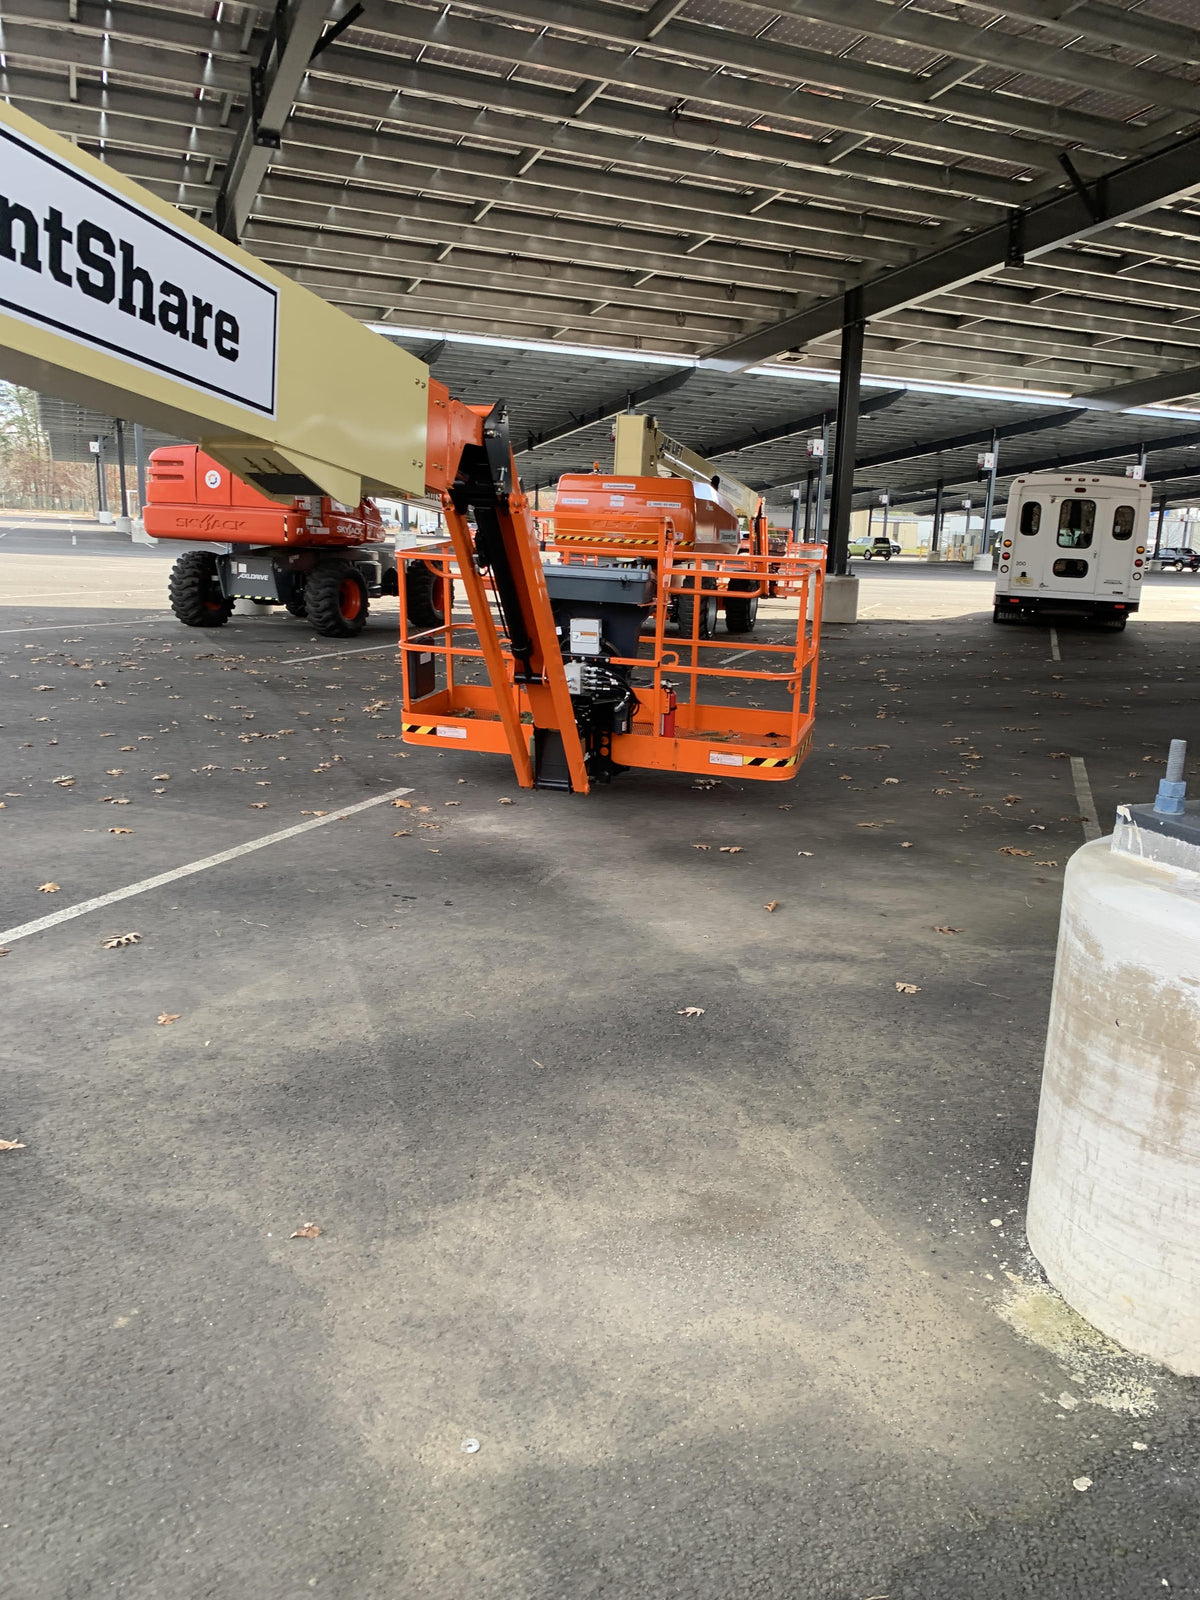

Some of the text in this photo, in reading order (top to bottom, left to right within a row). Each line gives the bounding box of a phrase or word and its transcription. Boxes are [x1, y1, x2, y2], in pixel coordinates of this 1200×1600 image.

[0, 194, 239, 363] ntShare
[176, 514, 246, 531] SKYJACK
[336, 523, 363, 536] SKYJACK
